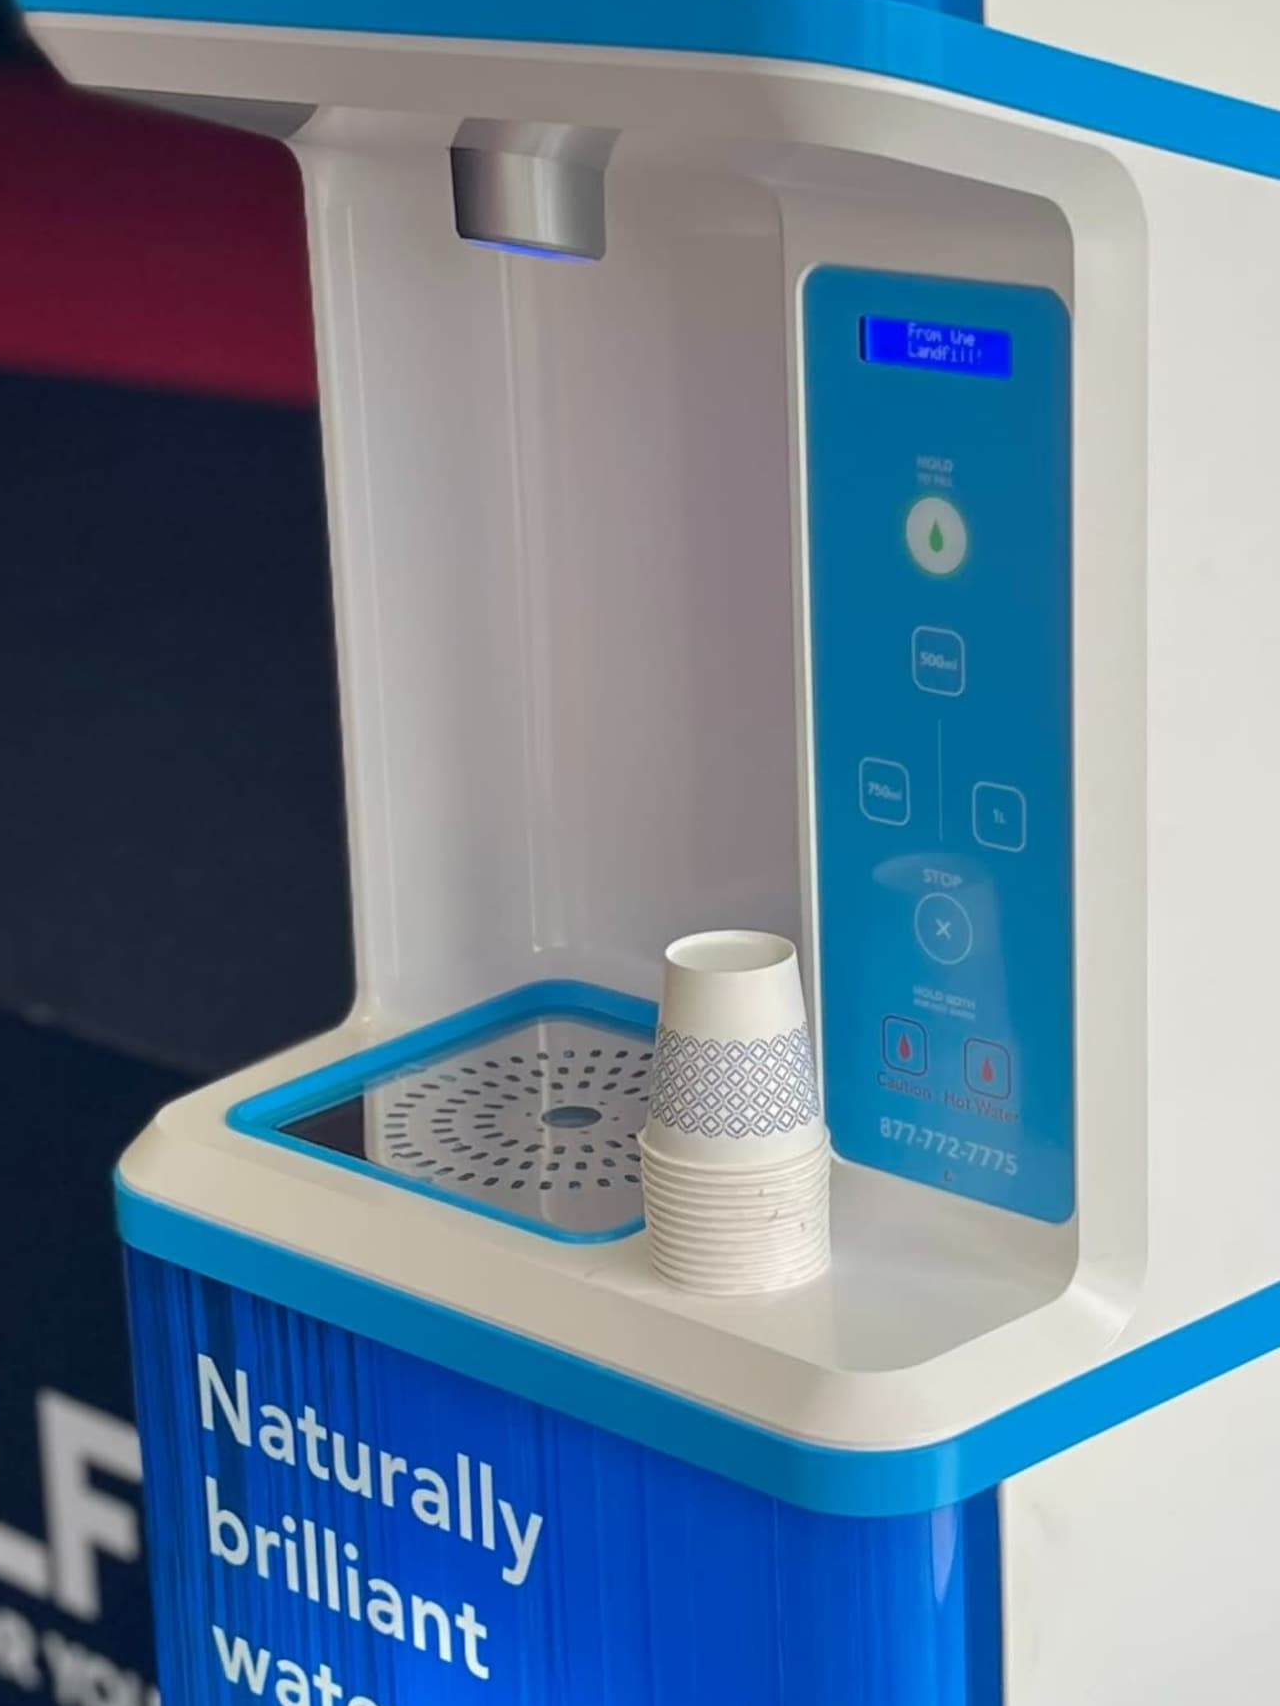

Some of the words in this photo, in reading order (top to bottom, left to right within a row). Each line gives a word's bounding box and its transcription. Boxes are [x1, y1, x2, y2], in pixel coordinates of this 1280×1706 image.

[907, 322, 942, 342] From
[950, 328, 976, 347] the
[922, 868, 963, 888] STOP
[876, 1071, 932, 1100] Caution
[943, 1090, 971, 1111] Hot
[975, 1099, 1020, 1124] Water
[879, 1116, 1019, 1176] 877-772-7775
[196, 1352, 544, 1586] Naturally
[205, 1475, 490, 1681] brilliant
